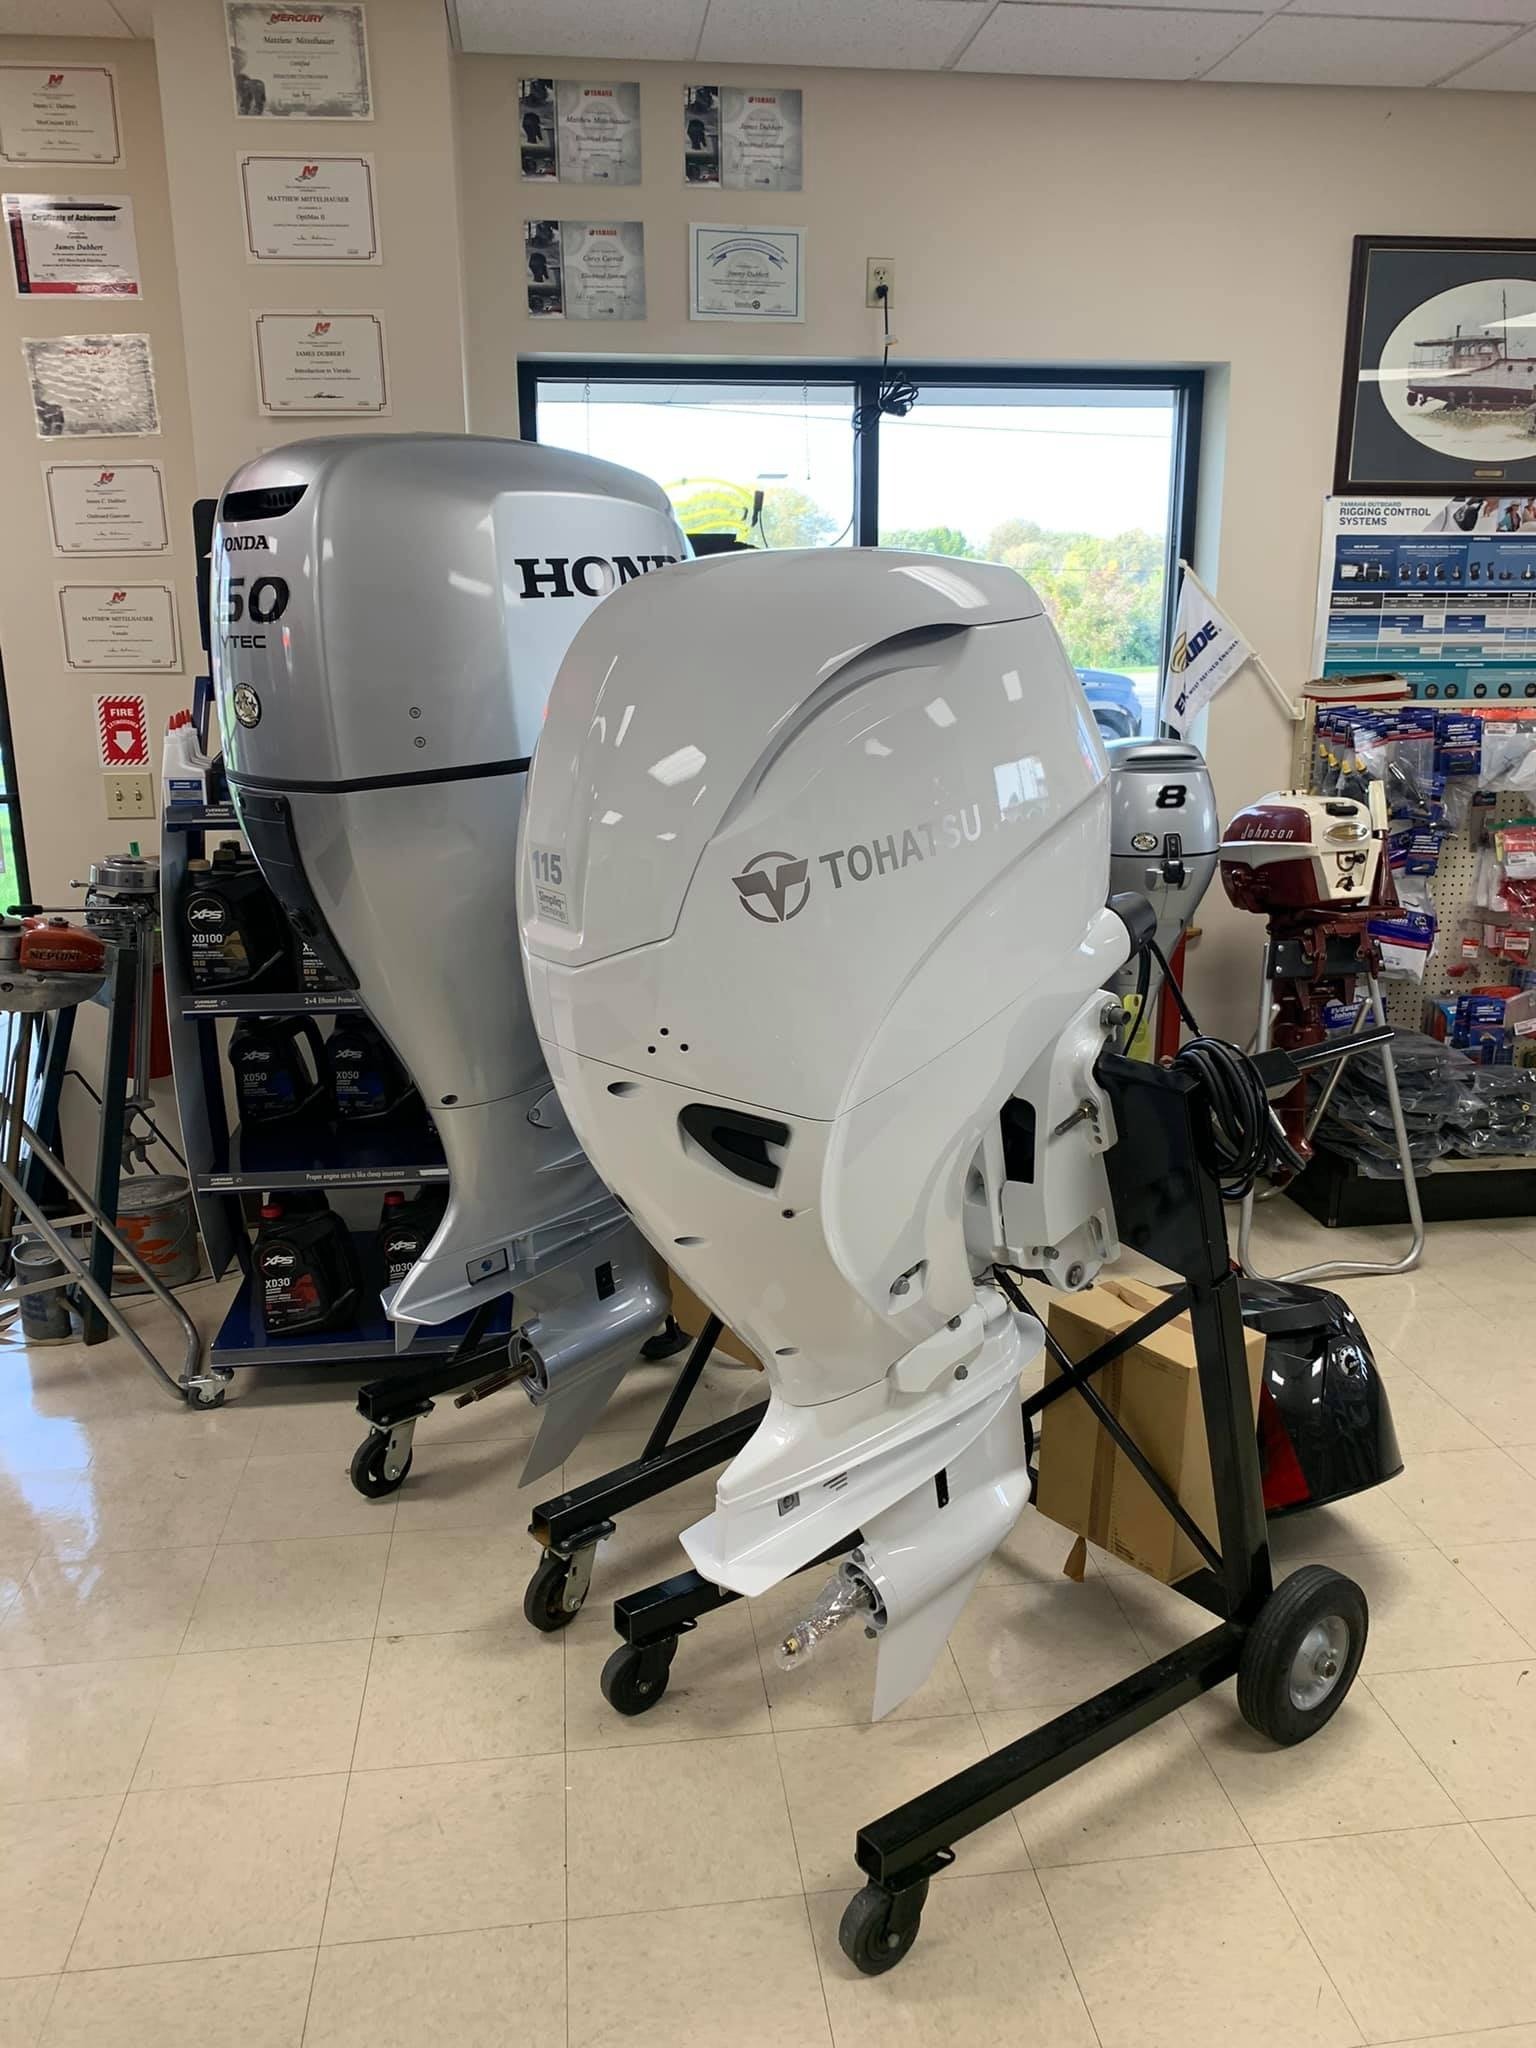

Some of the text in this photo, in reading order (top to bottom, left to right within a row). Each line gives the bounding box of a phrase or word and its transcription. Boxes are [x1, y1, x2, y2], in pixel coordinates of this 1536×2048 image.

[268, 13, 324, 24] MERCURY
[75, 214, 117, 222] Achievement
[55, 243, 76, 251] James
[1340, 507, 1431, 517] RIGGING CONTROL
[1339, 517, 1388, 526] SYSTEMS
[514, 555, 685, 599] HON
[221, 635, 267, 649] VTEC
[110, 708, 135, 717] FIRE
[1155, 785, 1187, 809] 8
[1240, 823, 1295, 840] Johnson
[818, 803, 982, 890] TOHATSU
[532, 850, 562, 885] 115
[191, 908, 224, 920] XPS
[192, 933, 223, 944] XD100
[29, 948, 82, 962] NEPTUNE
[241, 1050, 272, 1061] XPS
[335, 1048, 363, 1059] XPS
[306, 1173, 323, 1182] Proper
[324, 1173, 339, 1181] engine
[367, 1171, 381, 1179] cheap
[381, 1170, 405, 1178] insurance
[388, 1240, 417, 1251] XPS
[264, 1254, 295, 1267] XPS
[390, 1262, 413, 1273] XD30
[265, 1277, 291, 1289] XD30
